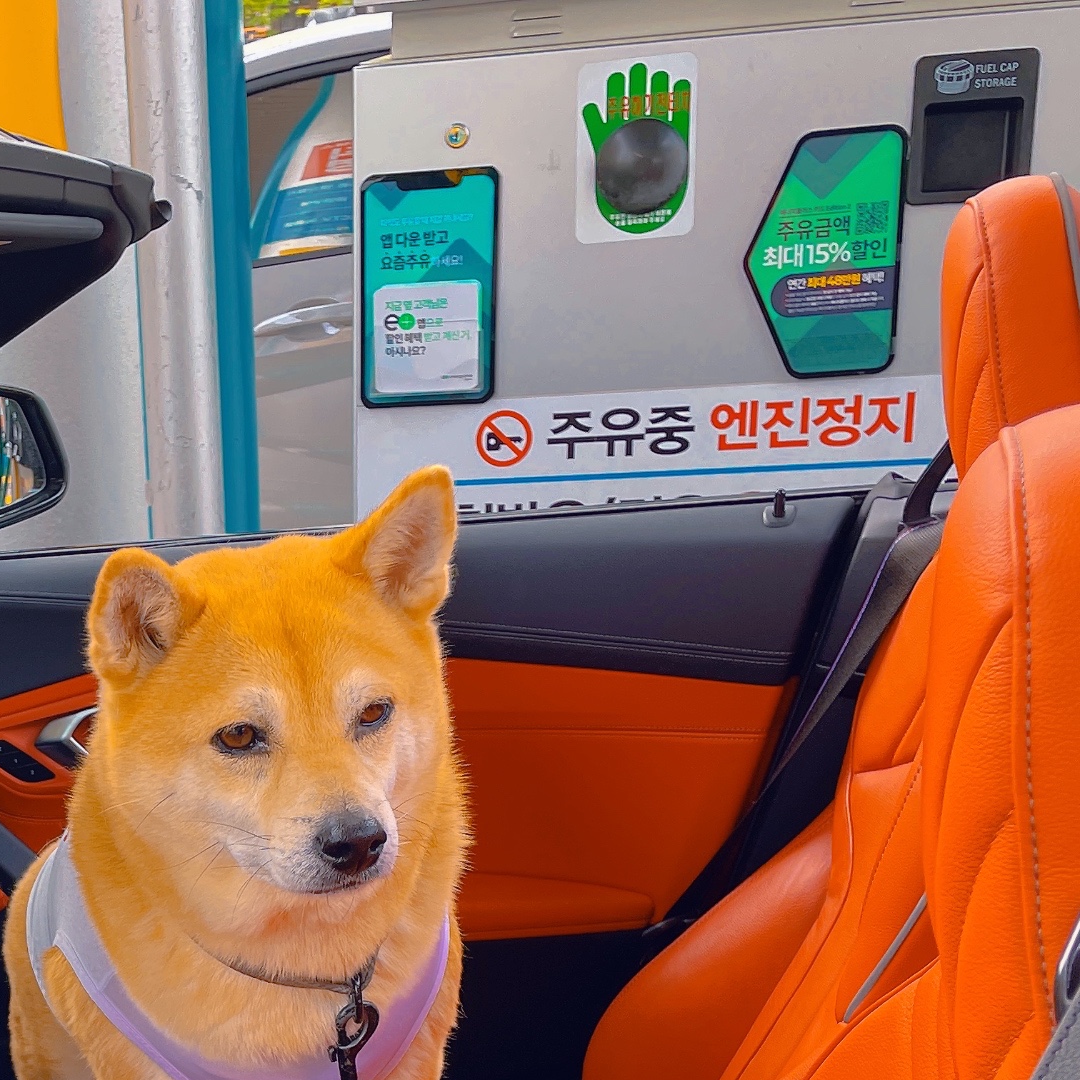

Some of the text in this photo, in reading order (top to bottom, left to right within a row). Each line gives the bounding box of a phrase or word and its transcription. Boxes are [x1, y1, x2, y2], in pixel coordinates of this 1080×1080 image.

[975, 61, 1020, 74] FUEL CAP
[974, 76, 1018, 89] STORAGE
[380, 230, 450, 249] 앱 다운 받고
[776, 215, 851, 242] 주유금액
[762, 238, 888, 270] 최대 15% 할인
[547, 391, 917, 460] 주유중 엔진정지
